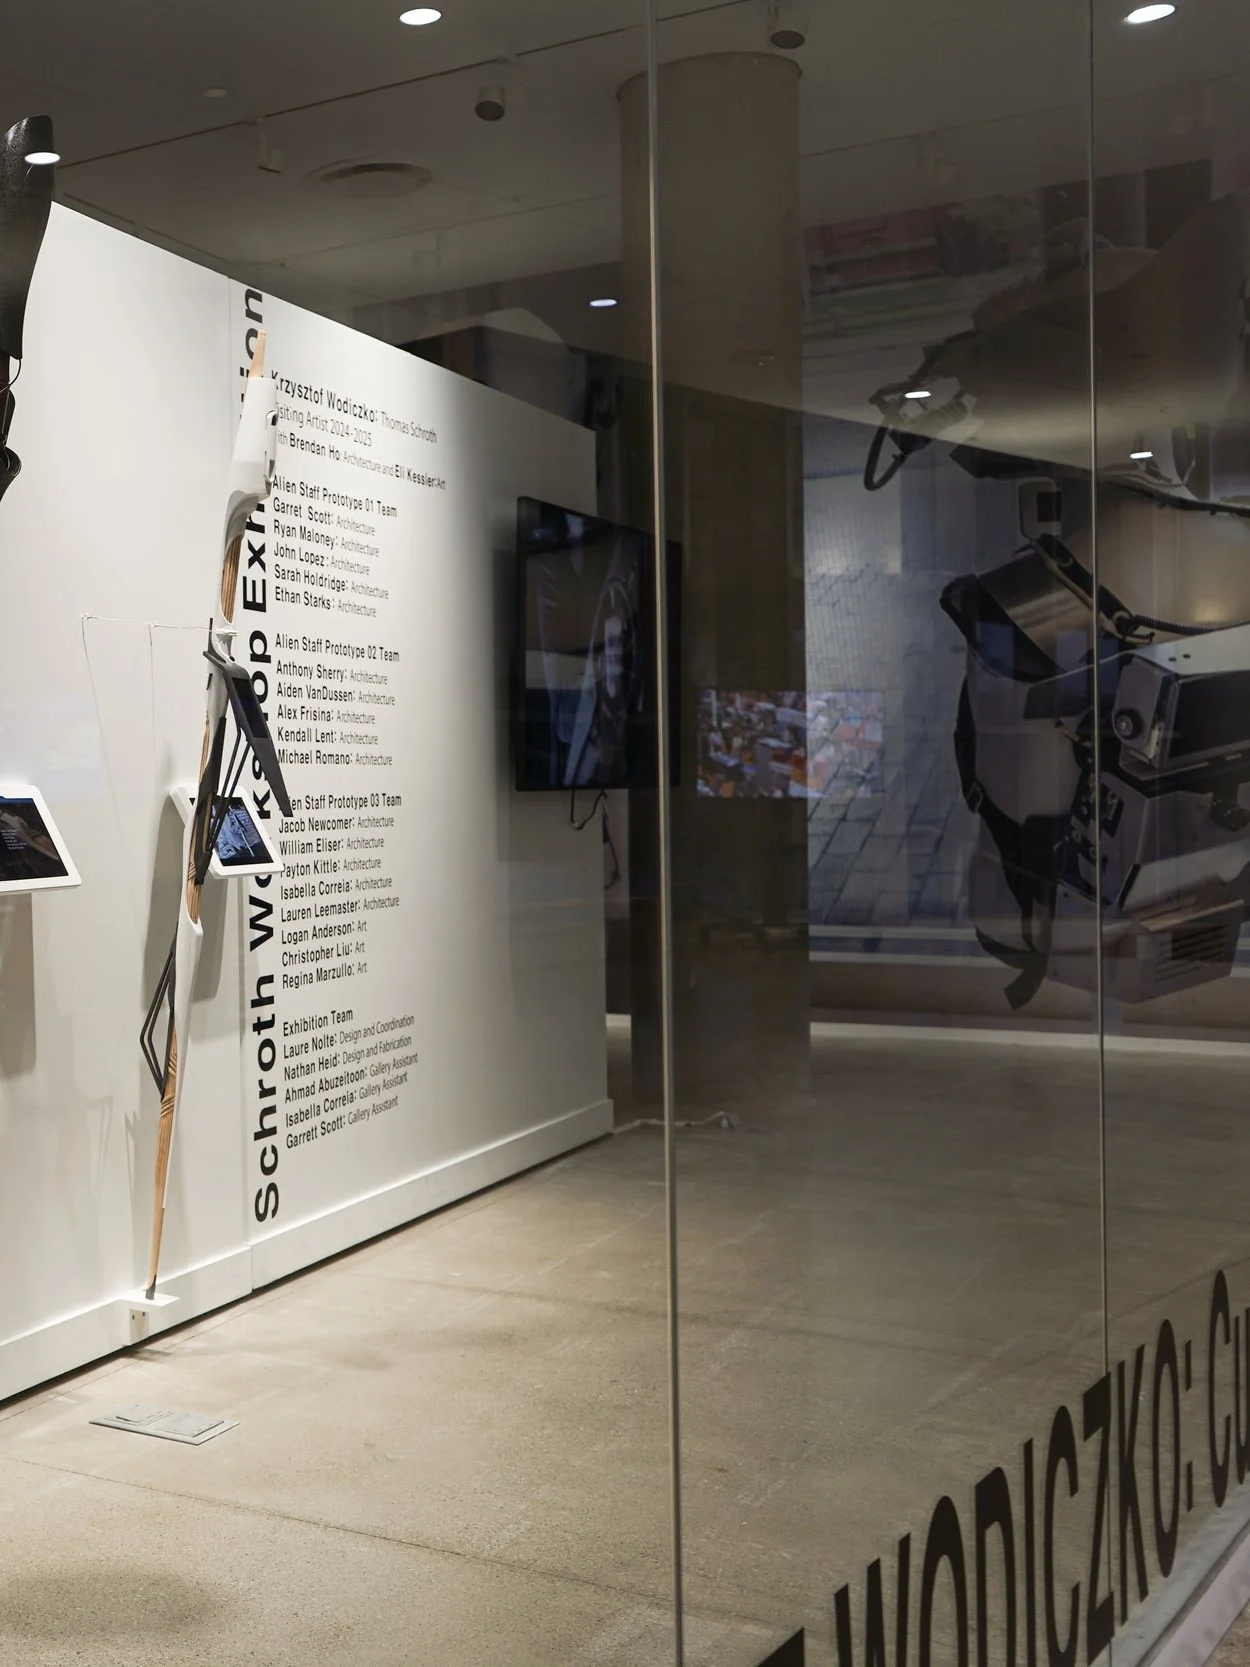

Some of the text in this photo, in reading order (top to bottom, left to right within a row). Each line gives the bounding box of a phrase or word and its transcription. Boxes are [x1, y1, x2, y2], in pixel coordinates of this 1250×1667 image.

[276, 402, 303, 428] isiting
[327, 390, 378, 423] Wodiczko:
[278, 434, 287, 446] ith
[273, 475, 296, 494] Alien
[337, 516, 375, 536] Architecture
[341, 537, 379, 557] Architecture
[331, 556, 369, 575] Architecture
[351, 581, 388, 599] Architecture
[338, 600, 377, 618] Architecture
[276, 633, 399, 662] Alien Staff Prototype 02 Team
[350, 670, 388, 685] Architecture
[358, 691, 395, 706] Architecture
[337, 710, 375, 725] Architecture
[340, 731, 378, 745] Architecture
[278, 749, 312, 764] Michael
[356, 752, 392, 766] Architecture
[249, 630, 274, 952] Wksop
[305, 795, 325, 809] Staff
[329, 795, 368, 810] Prototype
[370, 794, 379, 807] 03
[382, 793, 402, 806] Team
[357, 815, 394, 828] Architecture
[347, 836, 384, 850] Architecture
[343, 857, 381, 871] Architecture
[355, 875, 392, 891] Architecture
[363, 896, 399, 911] Architecture
[283, 1008, 353, 1036] Exhibition Team
[251, 974, 280, 1222] Schroth
[834, 1319, 1193, 1667] ODICZKO:
